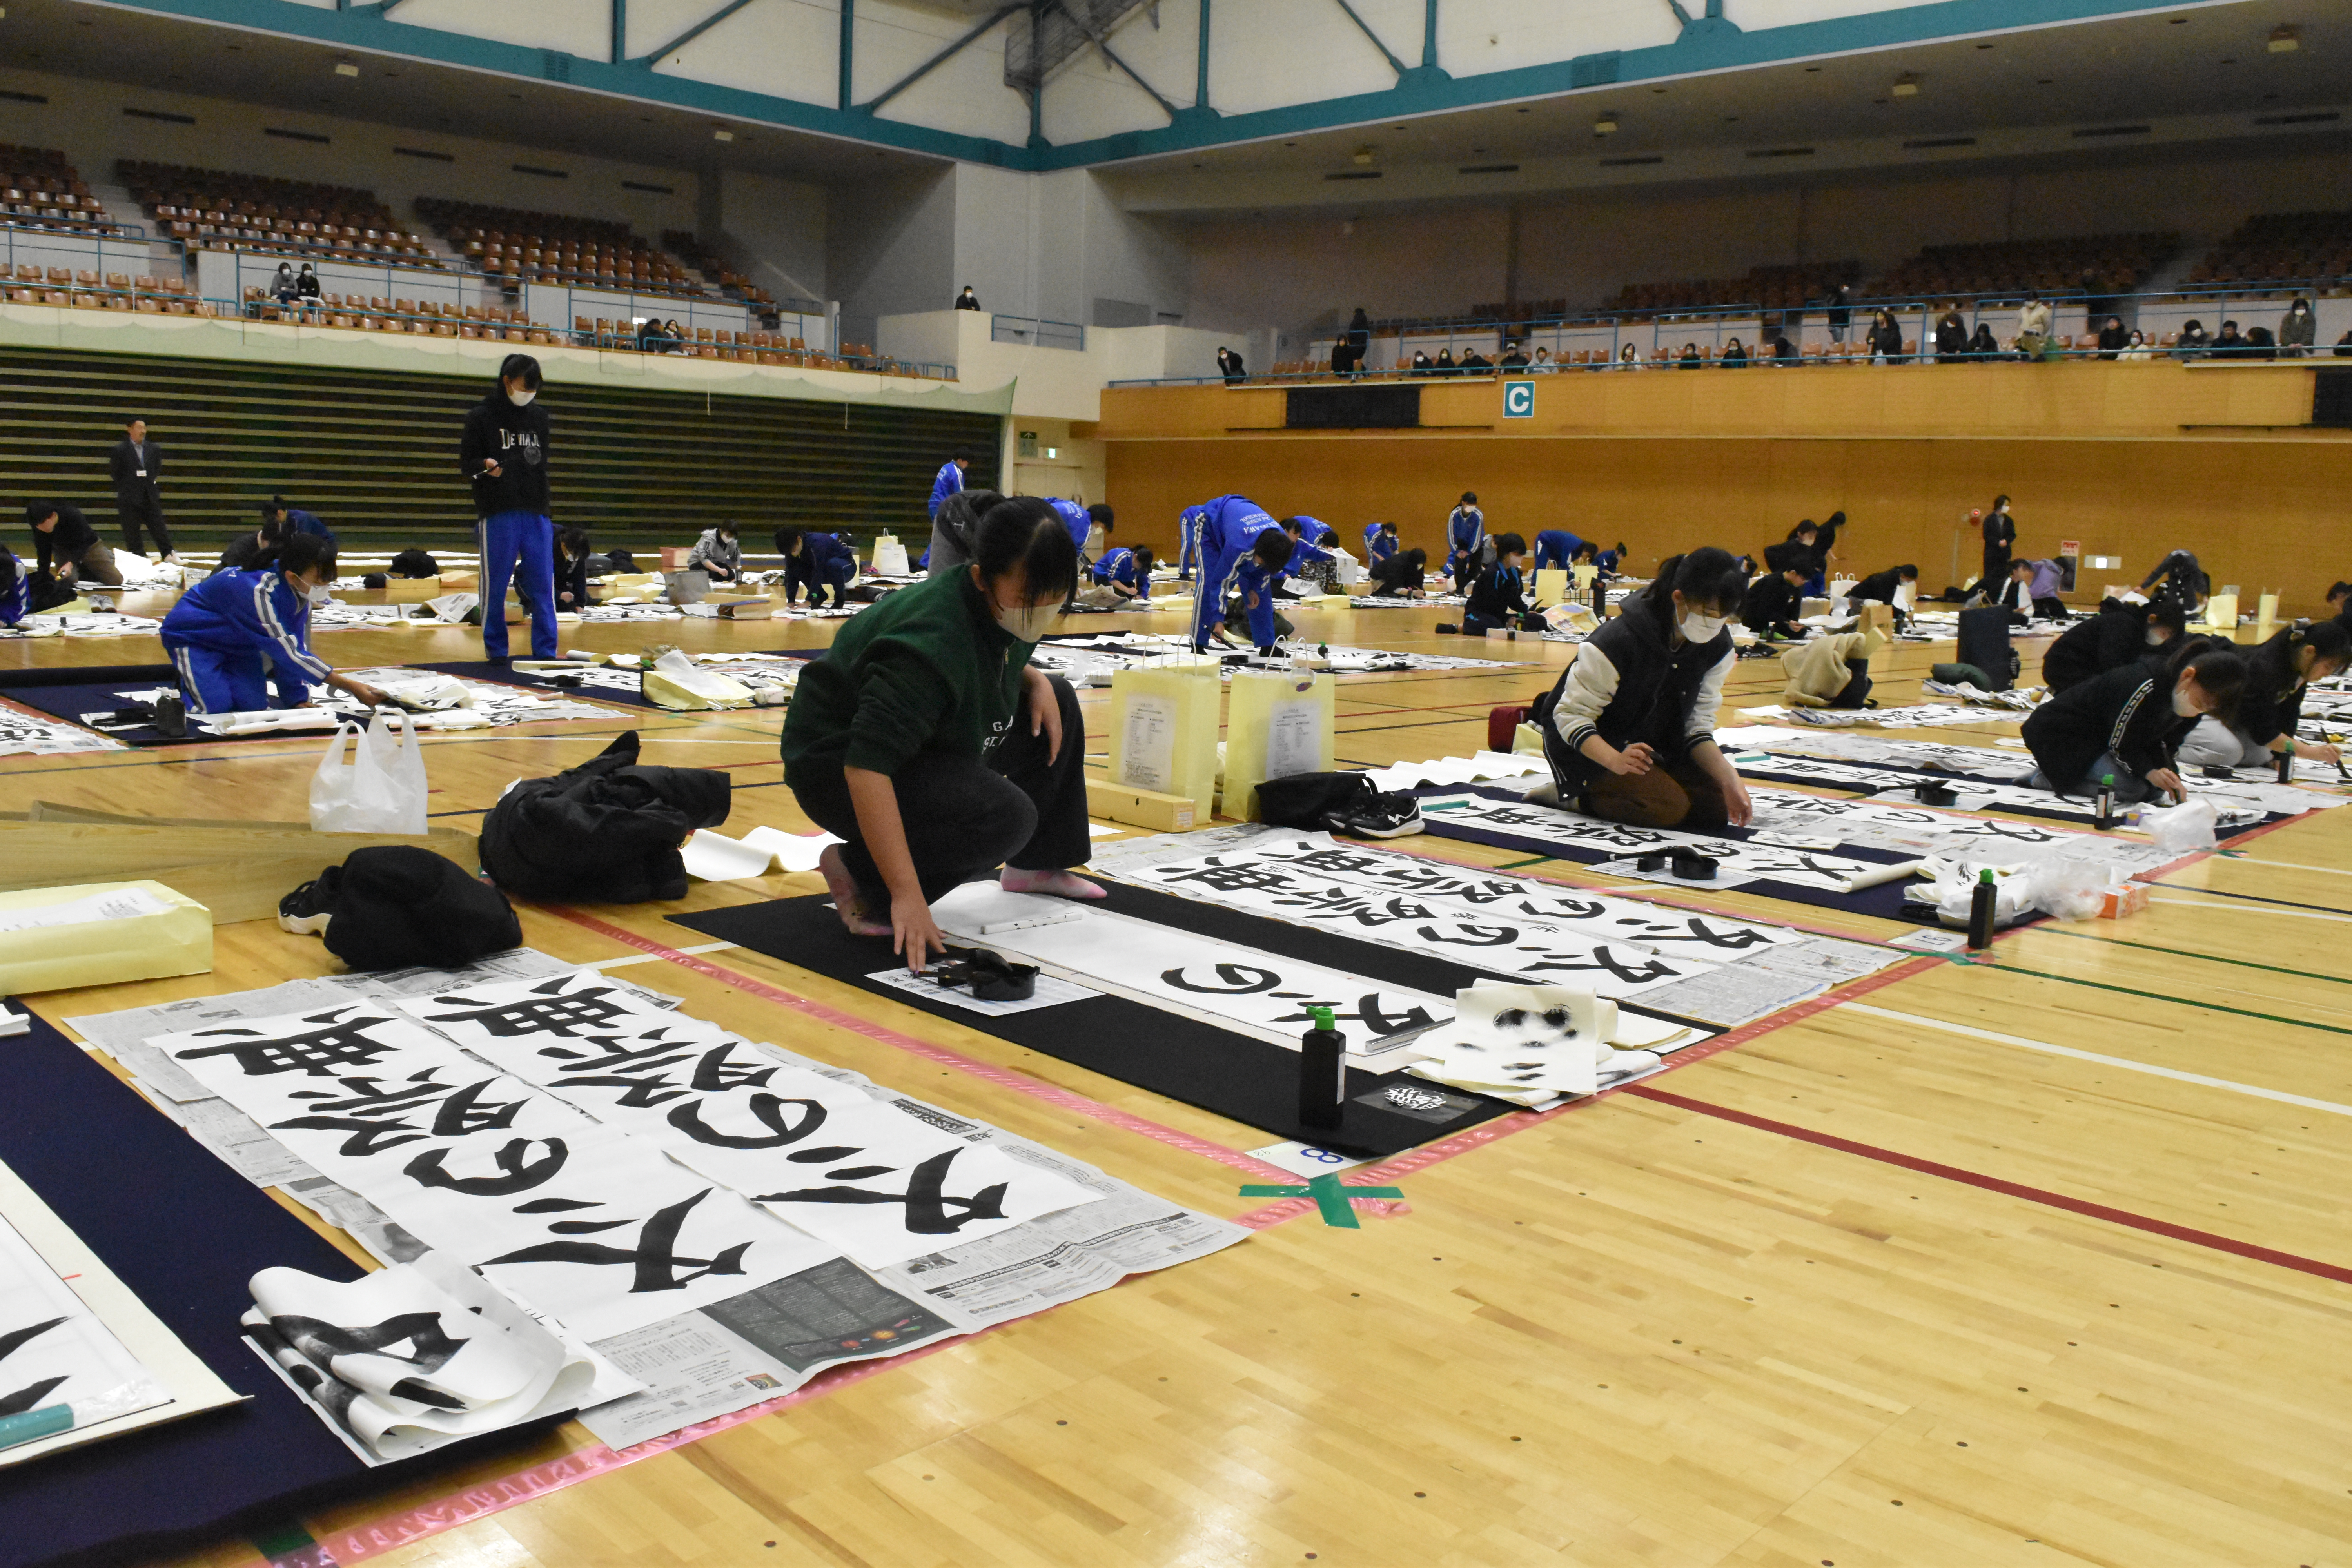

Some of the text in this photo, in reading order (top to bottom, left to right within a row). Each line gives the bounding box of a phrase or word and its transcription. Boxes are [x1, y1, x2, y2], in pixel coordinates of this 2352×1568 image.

[1509, 387, 1529, 412] C
[1163, 855, 1682, 983] 冬の祭典
[1260, 841, 1775, 949] 冬の祭典
[175, 1005, 755, 1293] 冬の祭典
[425, 975, 1010, 1234] 冬の祭典
